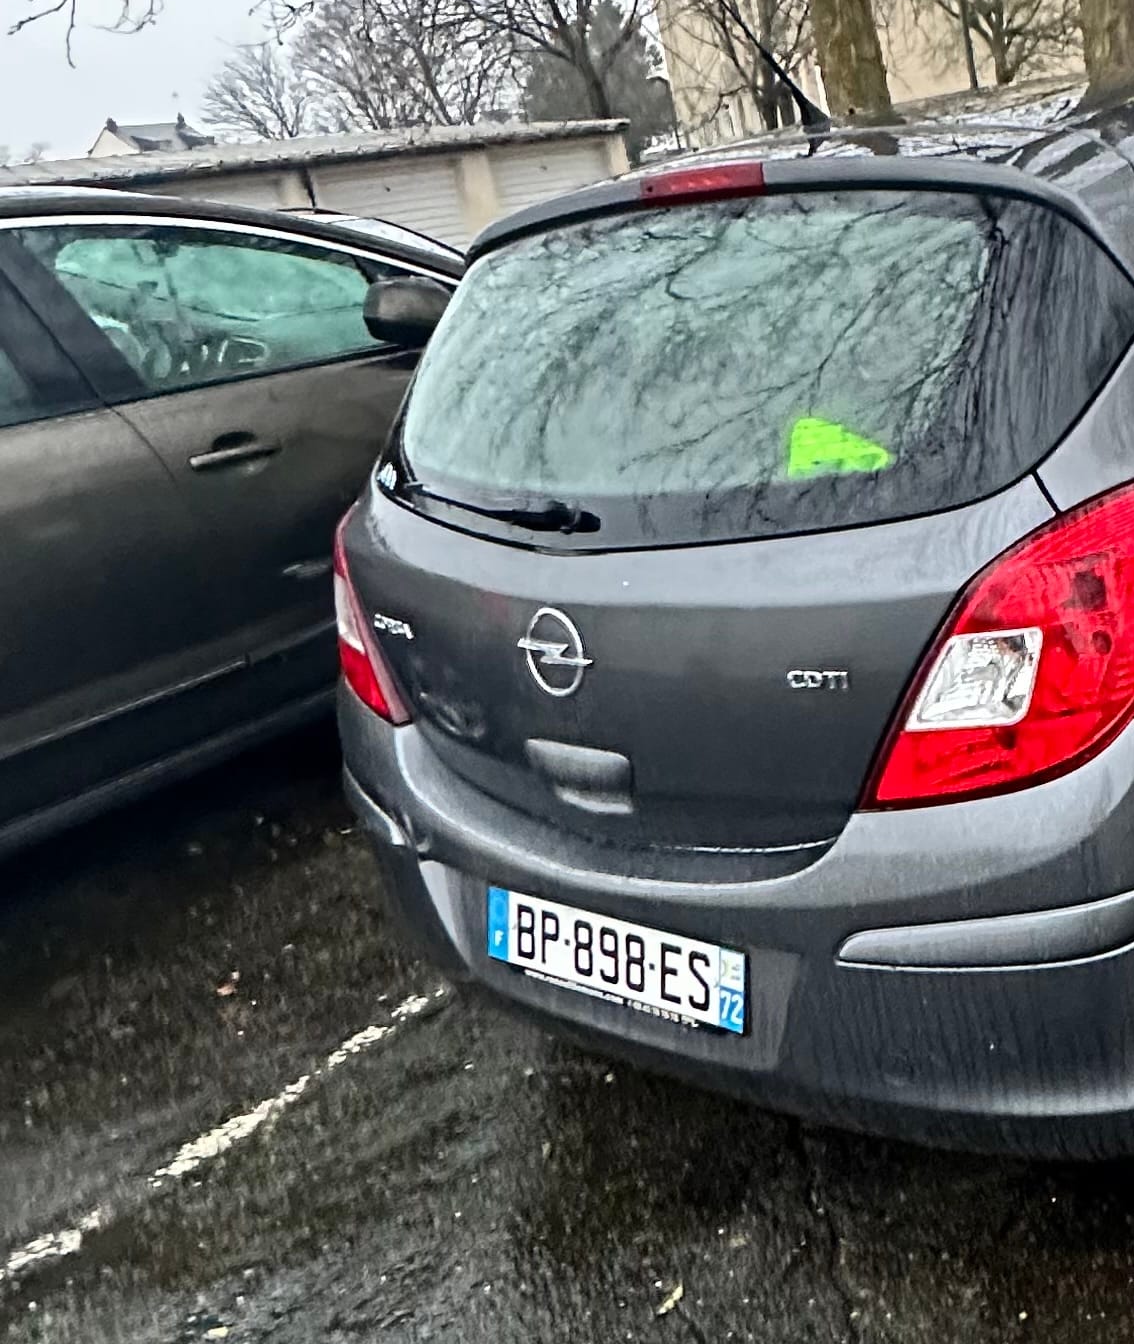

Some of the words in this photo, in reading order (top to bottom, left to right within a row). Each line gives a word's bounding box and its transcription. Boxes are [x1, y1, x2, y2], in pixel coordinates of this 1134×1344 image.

[786, 670, 849, 689] CDTI
[494, 929, 504, 947] F
[720, 989, 744, 1025] 72
